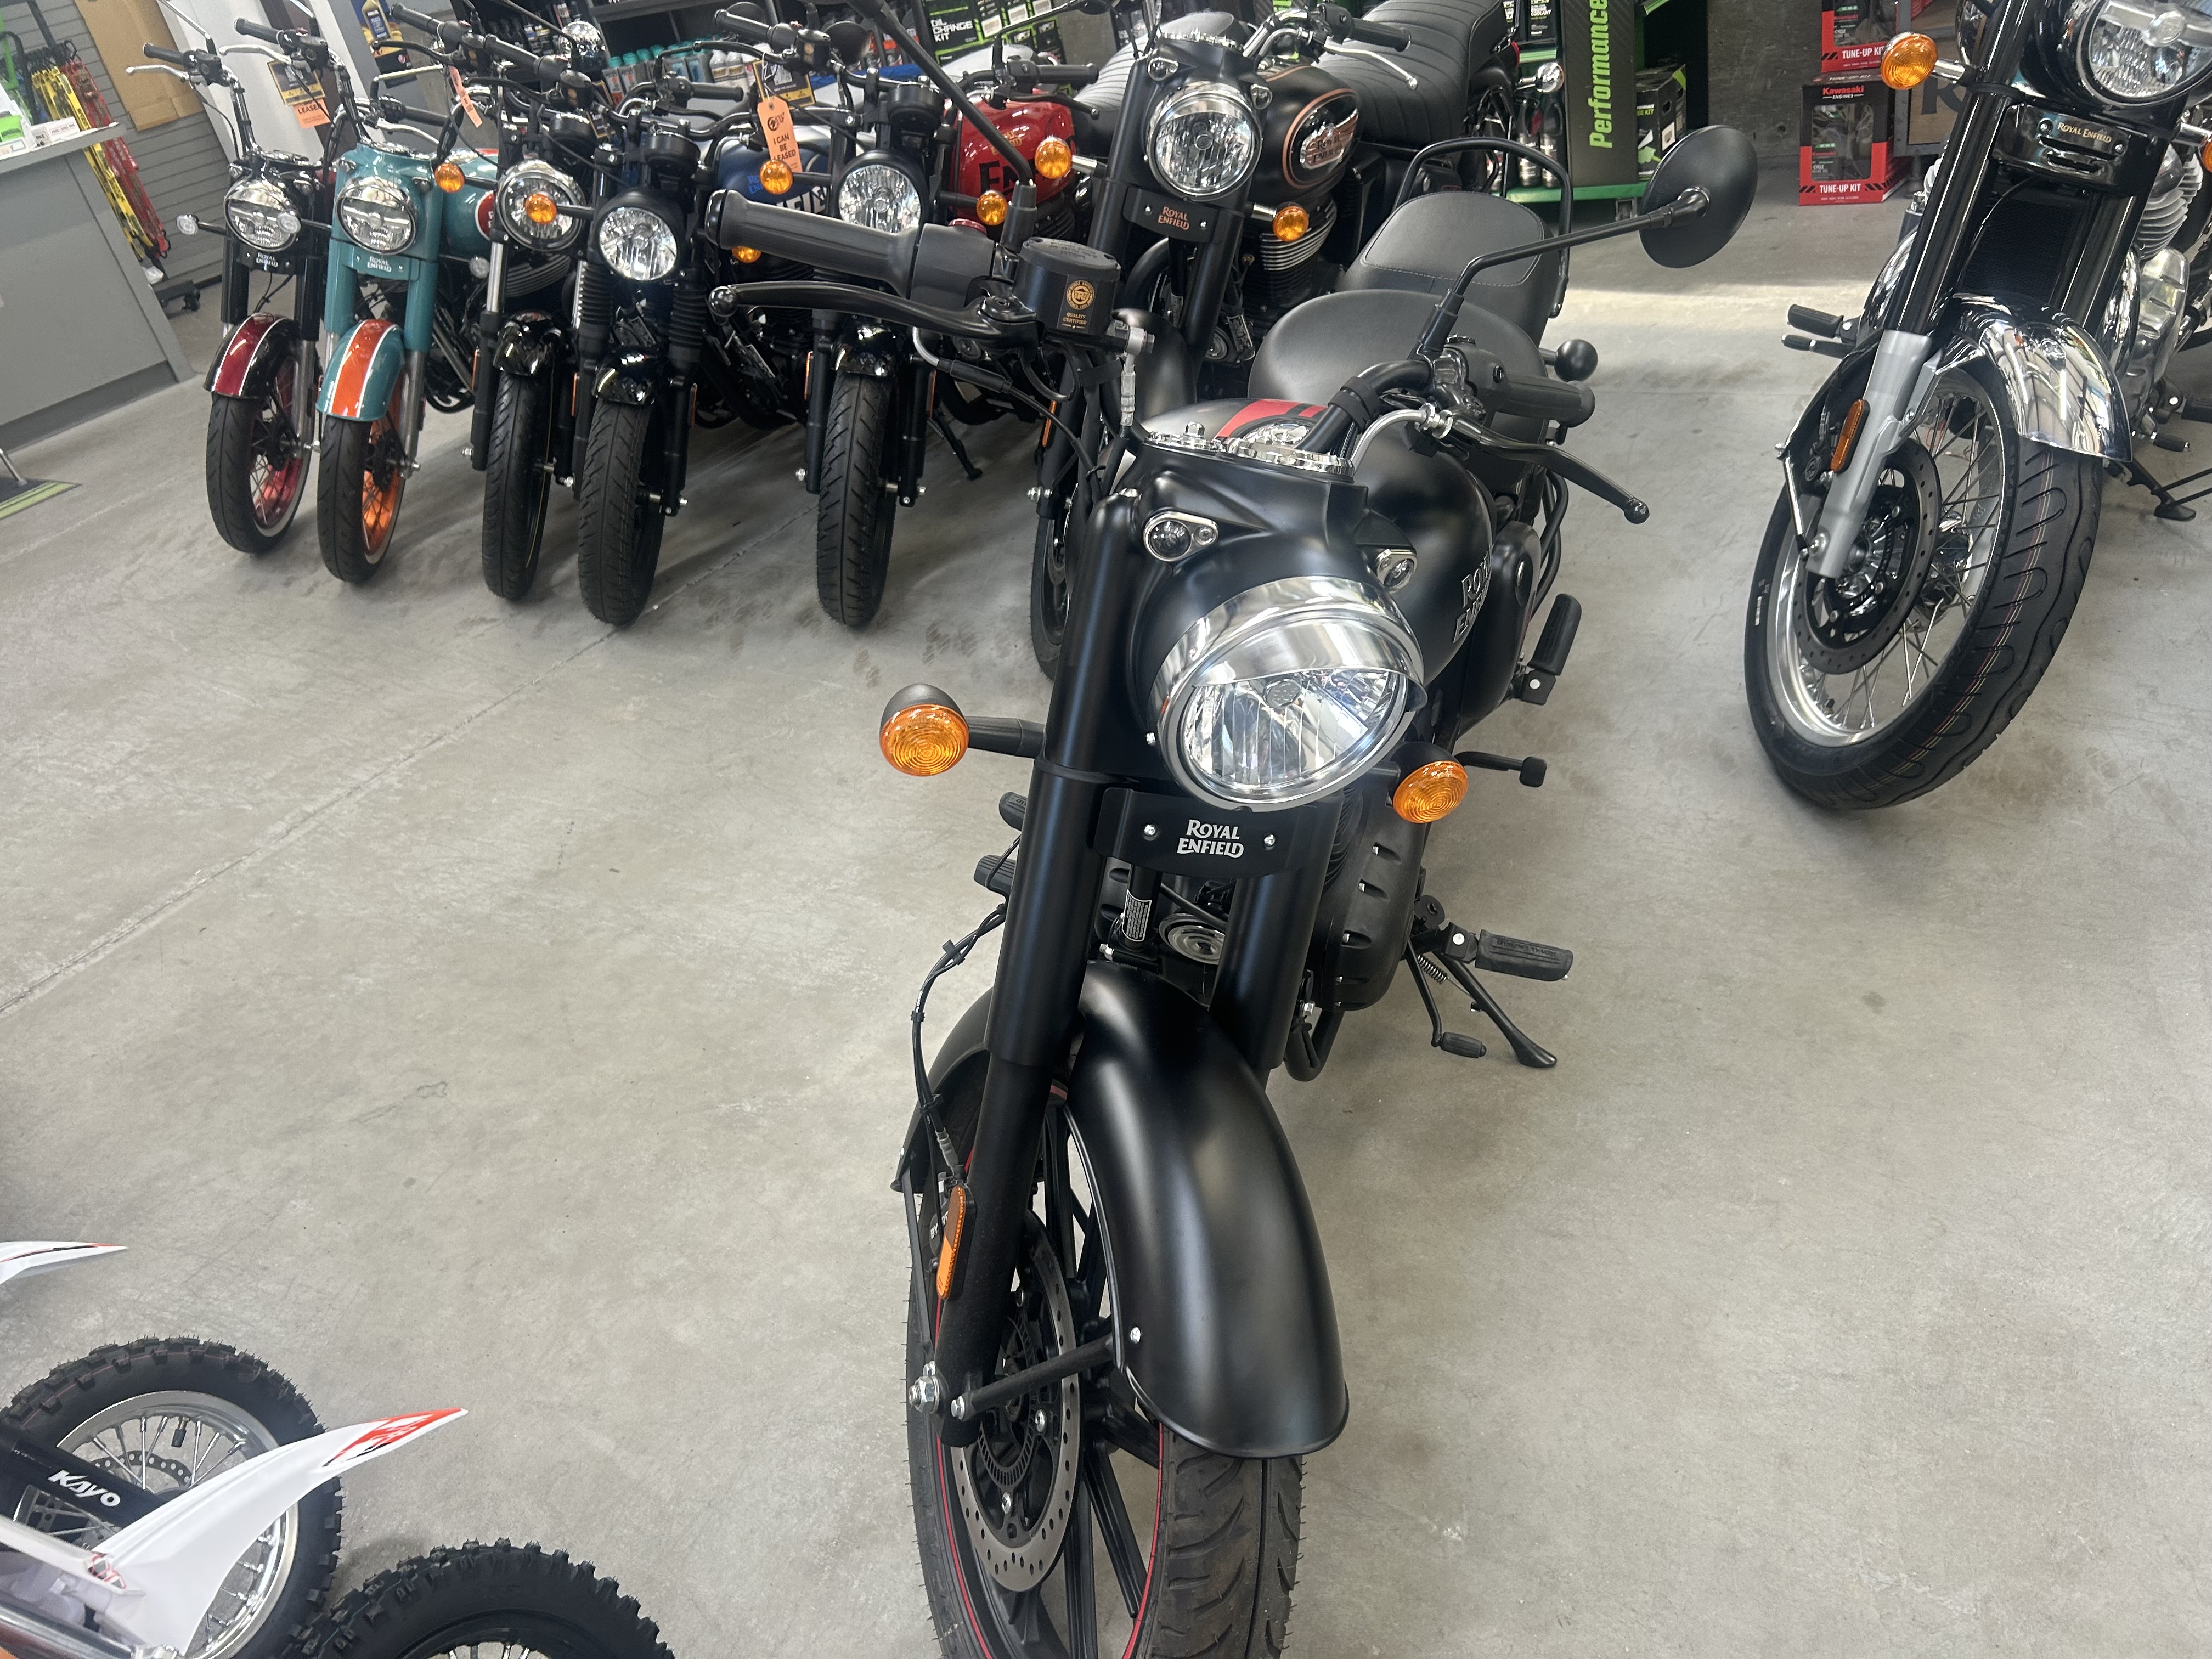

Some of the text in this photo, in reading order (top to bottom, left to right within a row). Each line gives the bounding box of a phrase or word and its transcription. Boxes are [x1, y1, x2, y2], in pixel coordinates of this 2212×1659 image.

[930, 18, 947, 27] OIL
[933, 20, 973, 34] CHANGE
[934, 32, 950, 42] KIT
[1842, 48, 1872, 59] TUNE-UP
[1588, 0, 1613, 149] Performance
[1822, 85, 1864, 95] Kawasaki
[297, 104, 322, 115] LEASE
[776, 132, 790, 144] CAN
[2057, 122, 2112, 143] ROYAL ENFIELD
[779, 143, 788, 153] BE
[1820, 183, 1861, 193] TUNE-UP KIT
[1163, 206, 1188, 221] ROYAL
[1158, 215, 1190, 230] ENFIELD
[1063, 317, 1087, 325] CERTIFIED
[1186, 819, 1240, 840] ROYAL
[1177, 838, 1244, 859] ENFIELD
[1530, 947, 1557, 957] ROYAL
[47, 1470, 121, 1507] KAYO
